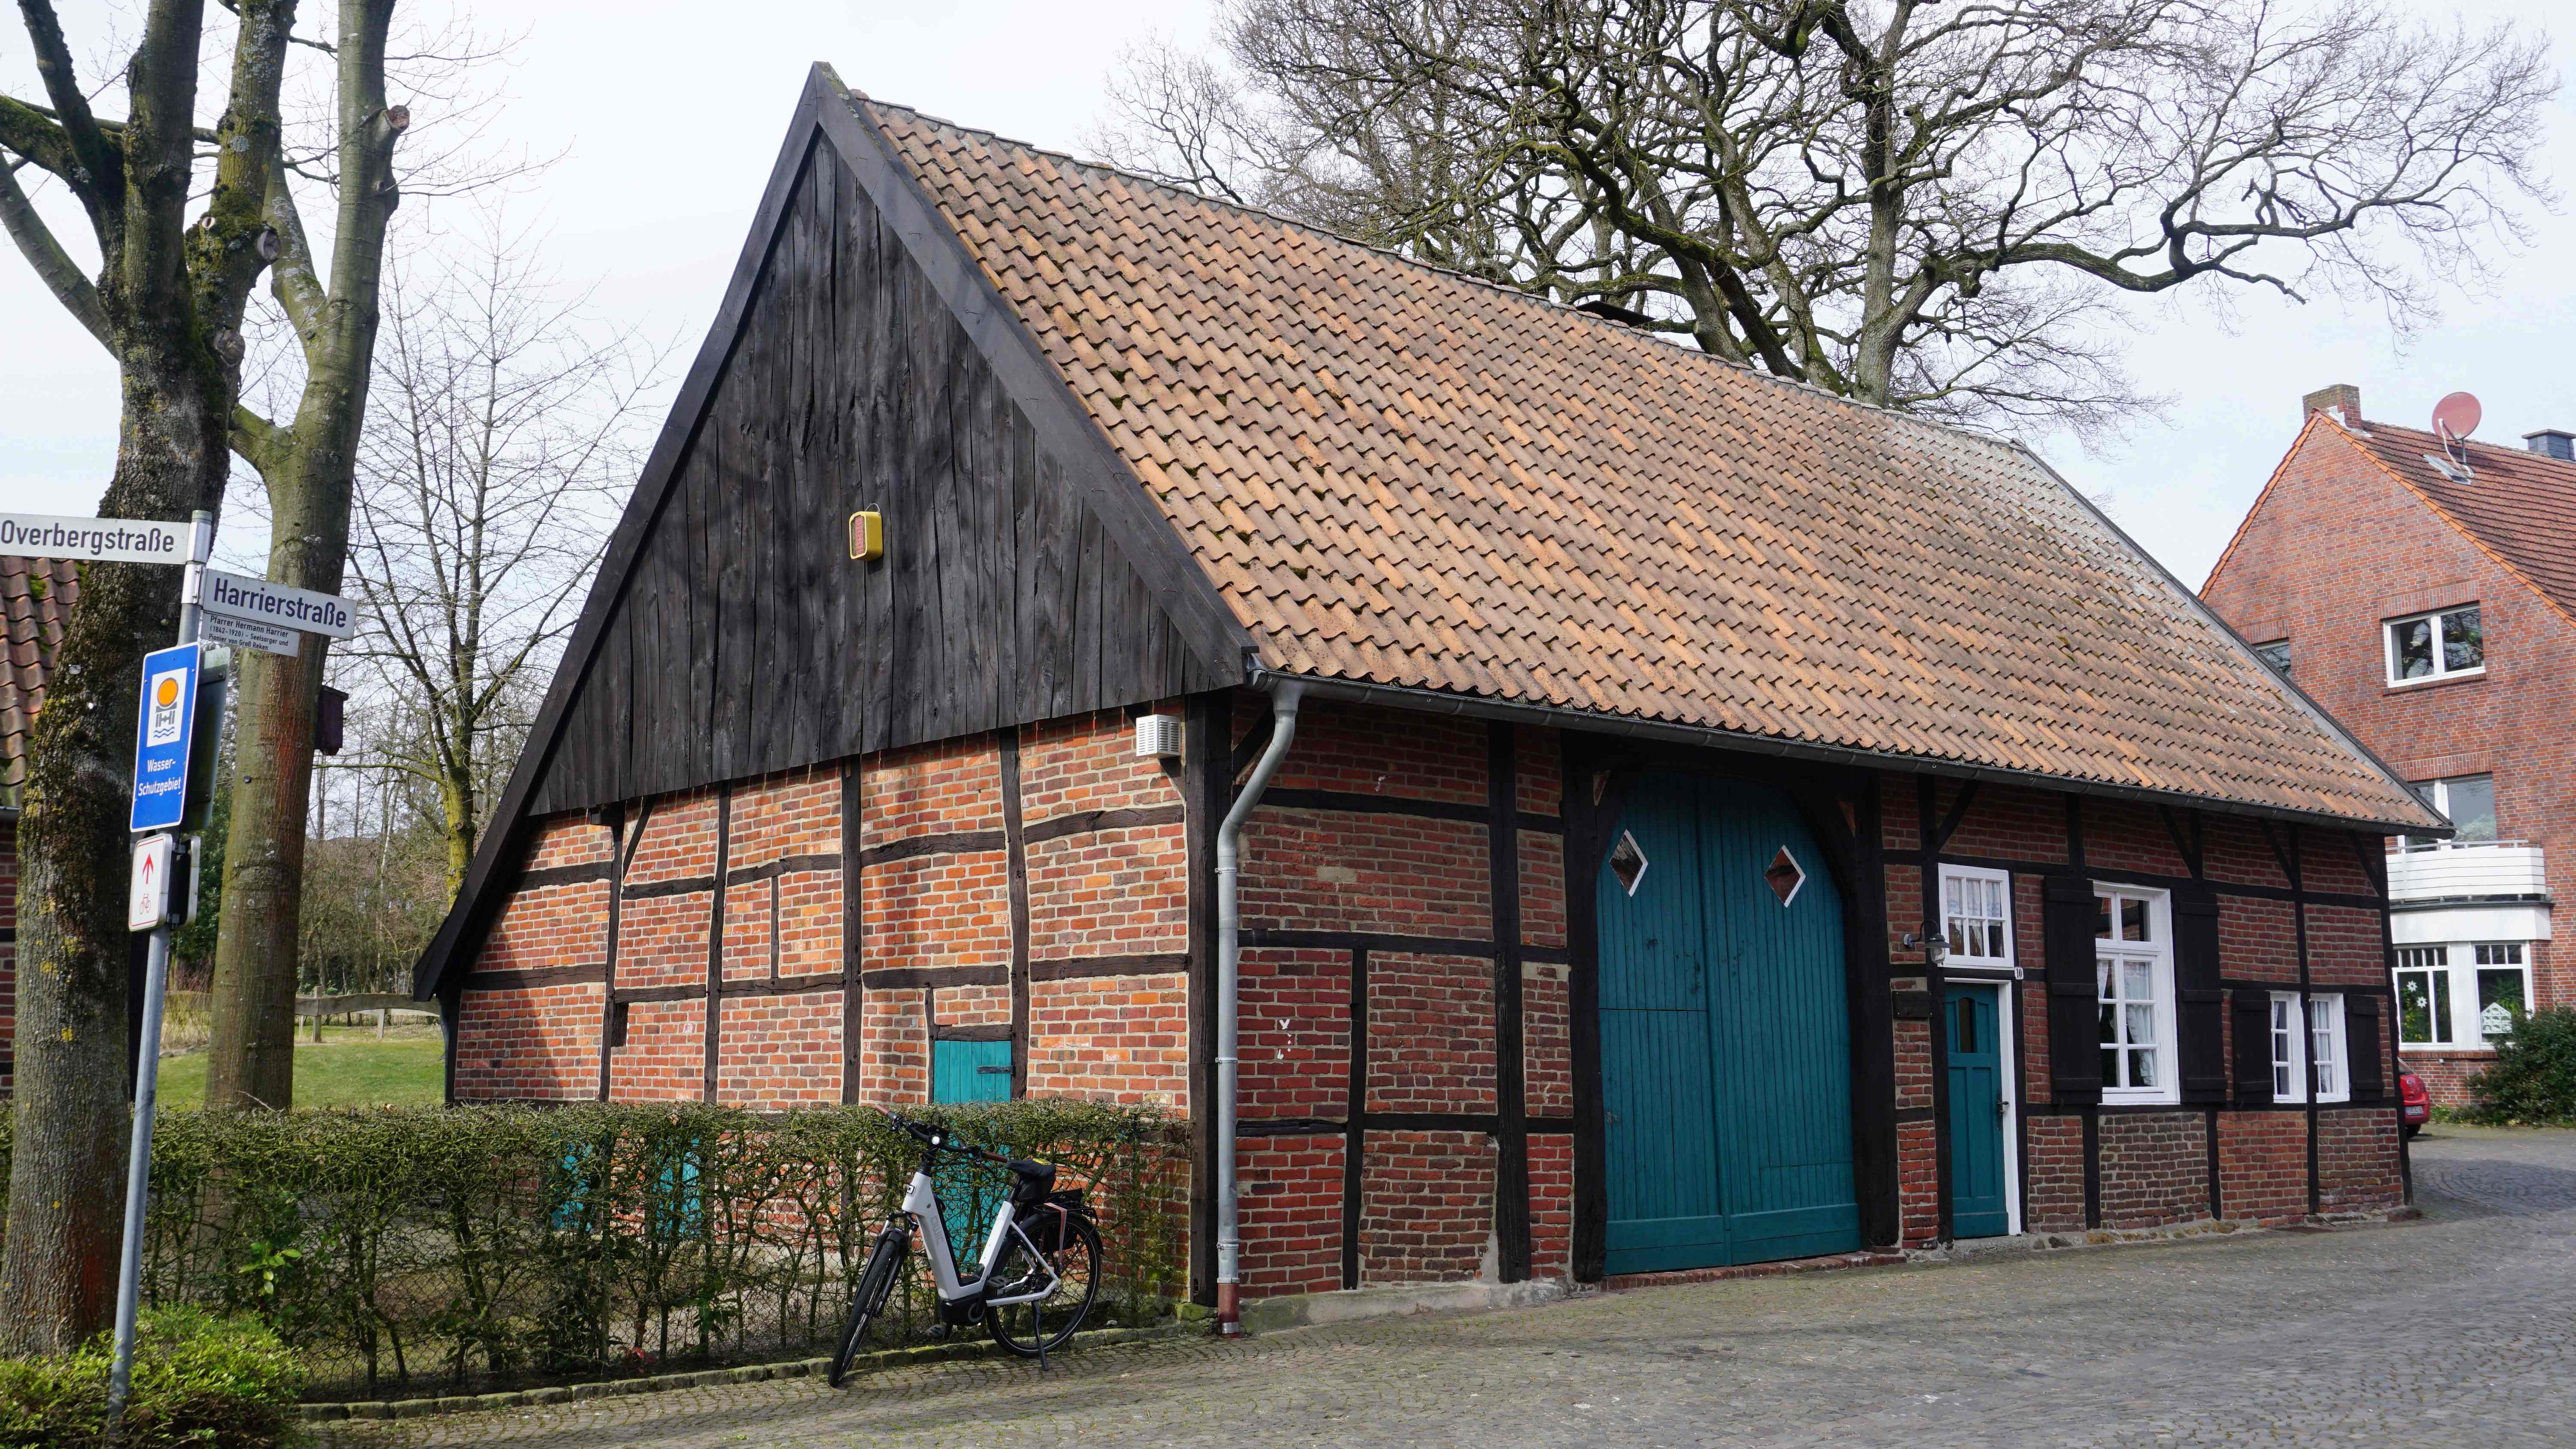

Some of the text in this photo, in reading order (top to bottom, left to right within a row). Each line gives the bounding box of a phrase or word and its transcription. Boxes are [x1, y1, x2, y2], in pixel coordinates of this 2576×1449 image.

[1, 519, 174, 556] Overbergstraße
[213, 577, 347, 628] Harrierstraße
[210, 615, 289, 638] Pfarrer Hermann Harrier
[210, 625, 243, 638] (1842-1920)
[250, 634, 278, 644] Seelsorger
[209, 634, 227, 643] Pionier
[252, 642, 268, 651] Reken
[147, 758, 176, 773] Wasser-
[138, 776, 181, 796] Schutzgebiet
[2016, 968, 2022, 978] 10
